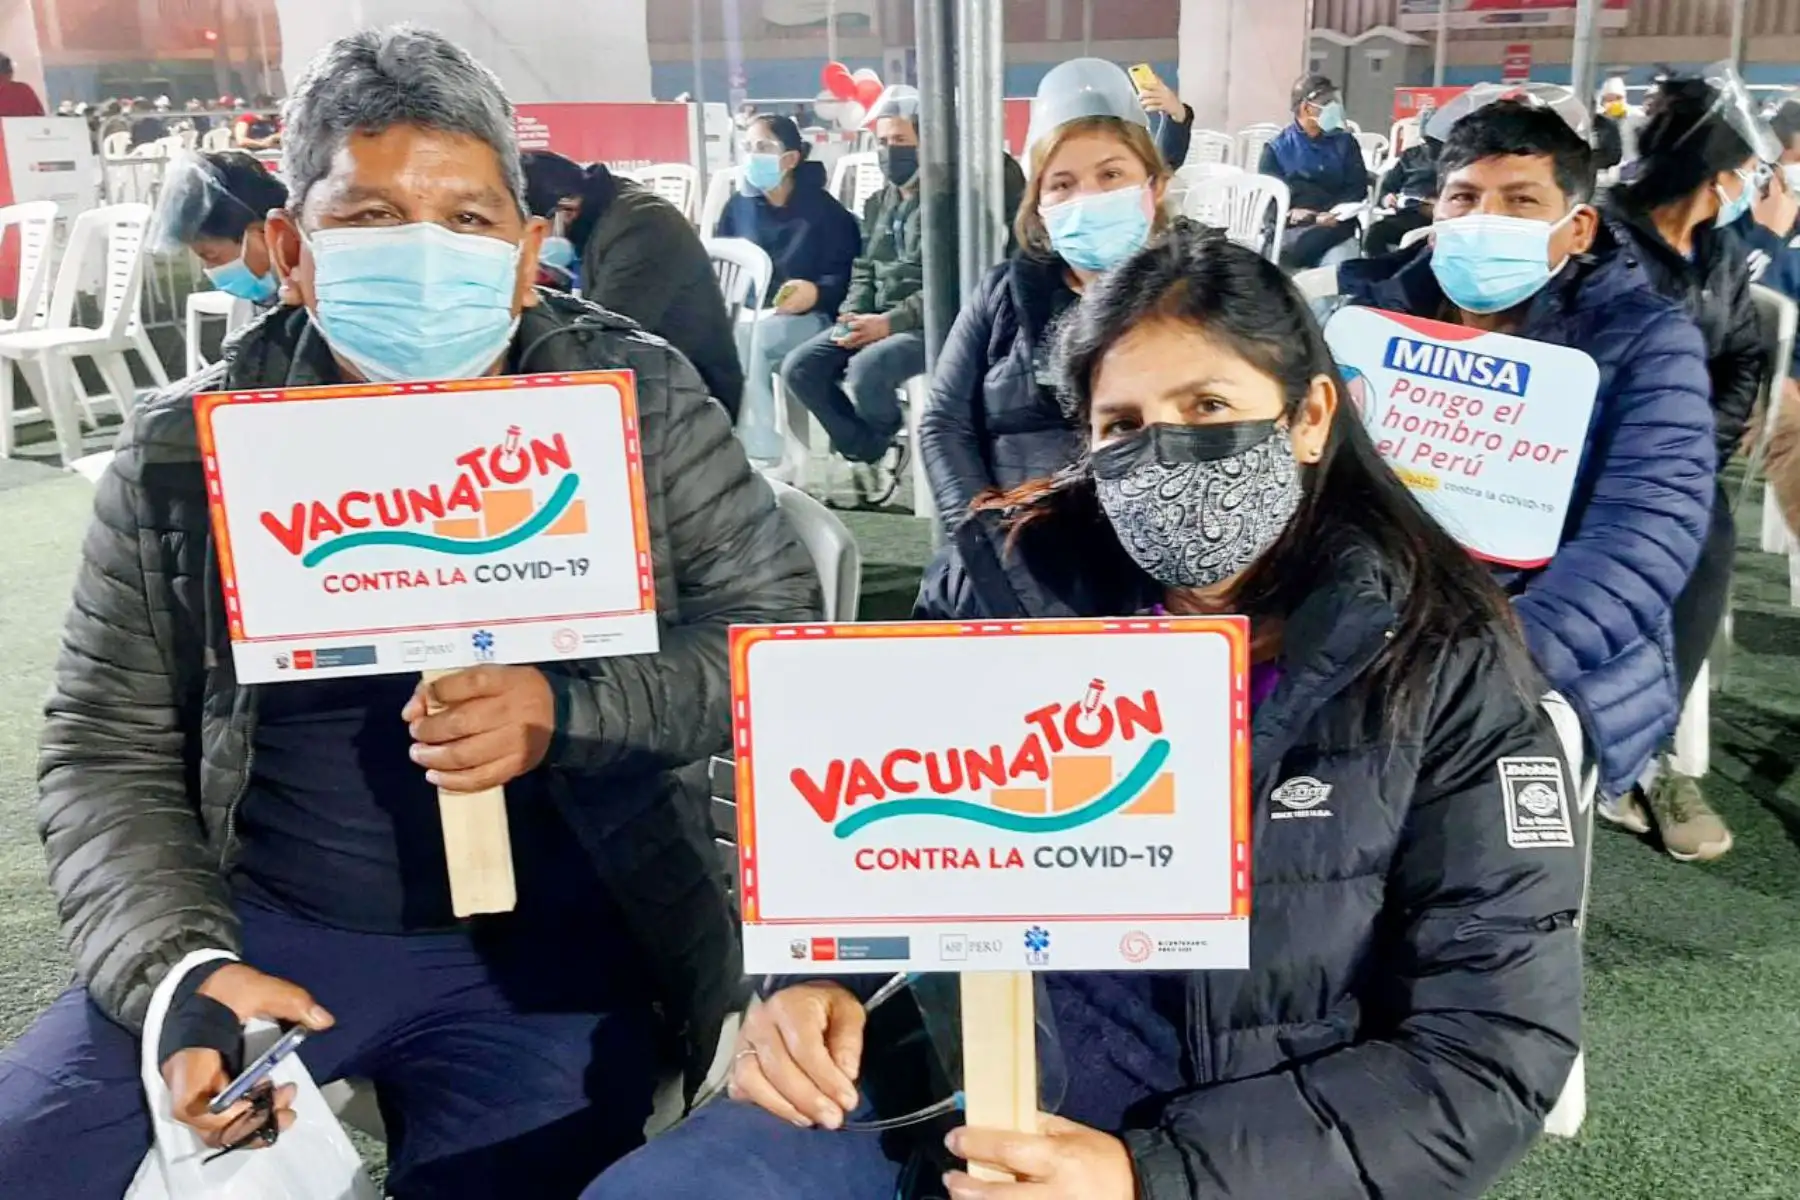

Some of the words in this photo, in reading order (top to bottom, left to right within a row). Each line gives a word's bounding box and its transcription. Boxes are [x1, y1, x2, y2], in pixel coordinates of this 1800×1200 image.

[1391, 339, 1521, 393] MINSA
[1389, 378, 1484, 419] Pongo
[1493, 402, 1526, 425] el
[1381, 404, 1502, 451] hombro
[1508, 438, 1569, 464] por
[1376, 436, 1405, 459] el
[1410, 442, 1485, 477] Perú
[1443, 481, 1483, 498] contra
[1485, 489, 1496, 501] la
[1498, 493, 1555, 513] COVID-19
[323, 569, 431, 594] CONTRA
[436, 567, 468, 588] LA
[474, 557, 590, 584] COVID-19
[854, 847, 981, 871] CONTRA
[988, 847, 1025, 870] LA
[1033, 845, 1174, 869] COVID-19
